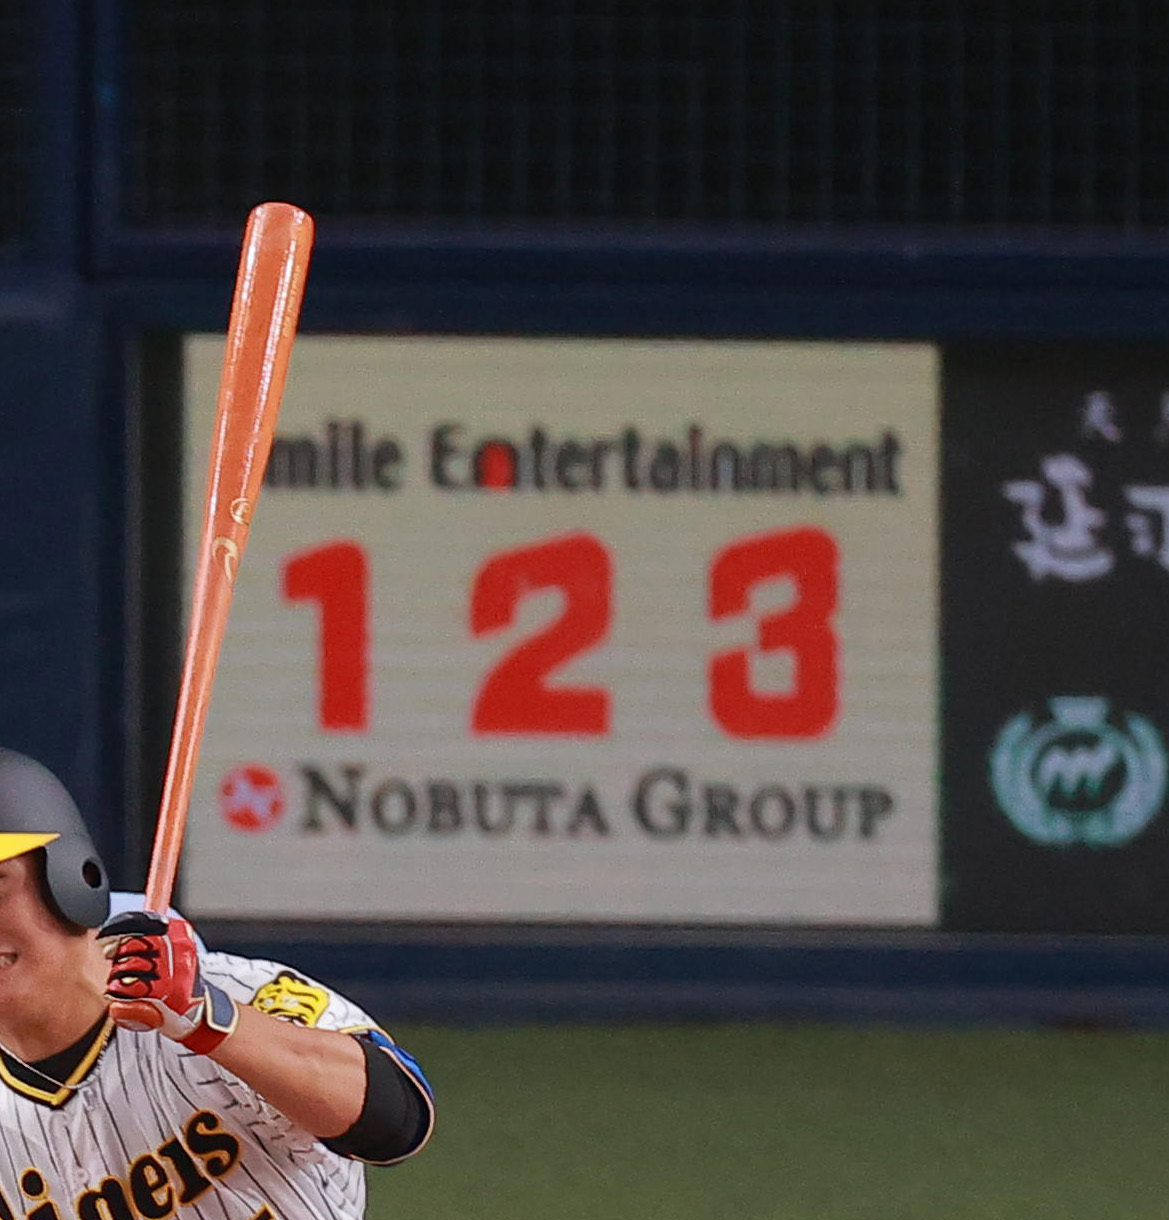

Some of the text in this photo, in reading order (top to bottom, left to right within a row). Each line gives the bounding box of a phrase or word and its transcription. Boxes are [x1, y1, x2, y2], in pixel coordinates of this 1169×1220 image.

[262, 420, 900, 494] mile Entertainment
[302, 763, 894, 840] NOBUTA GROUP
